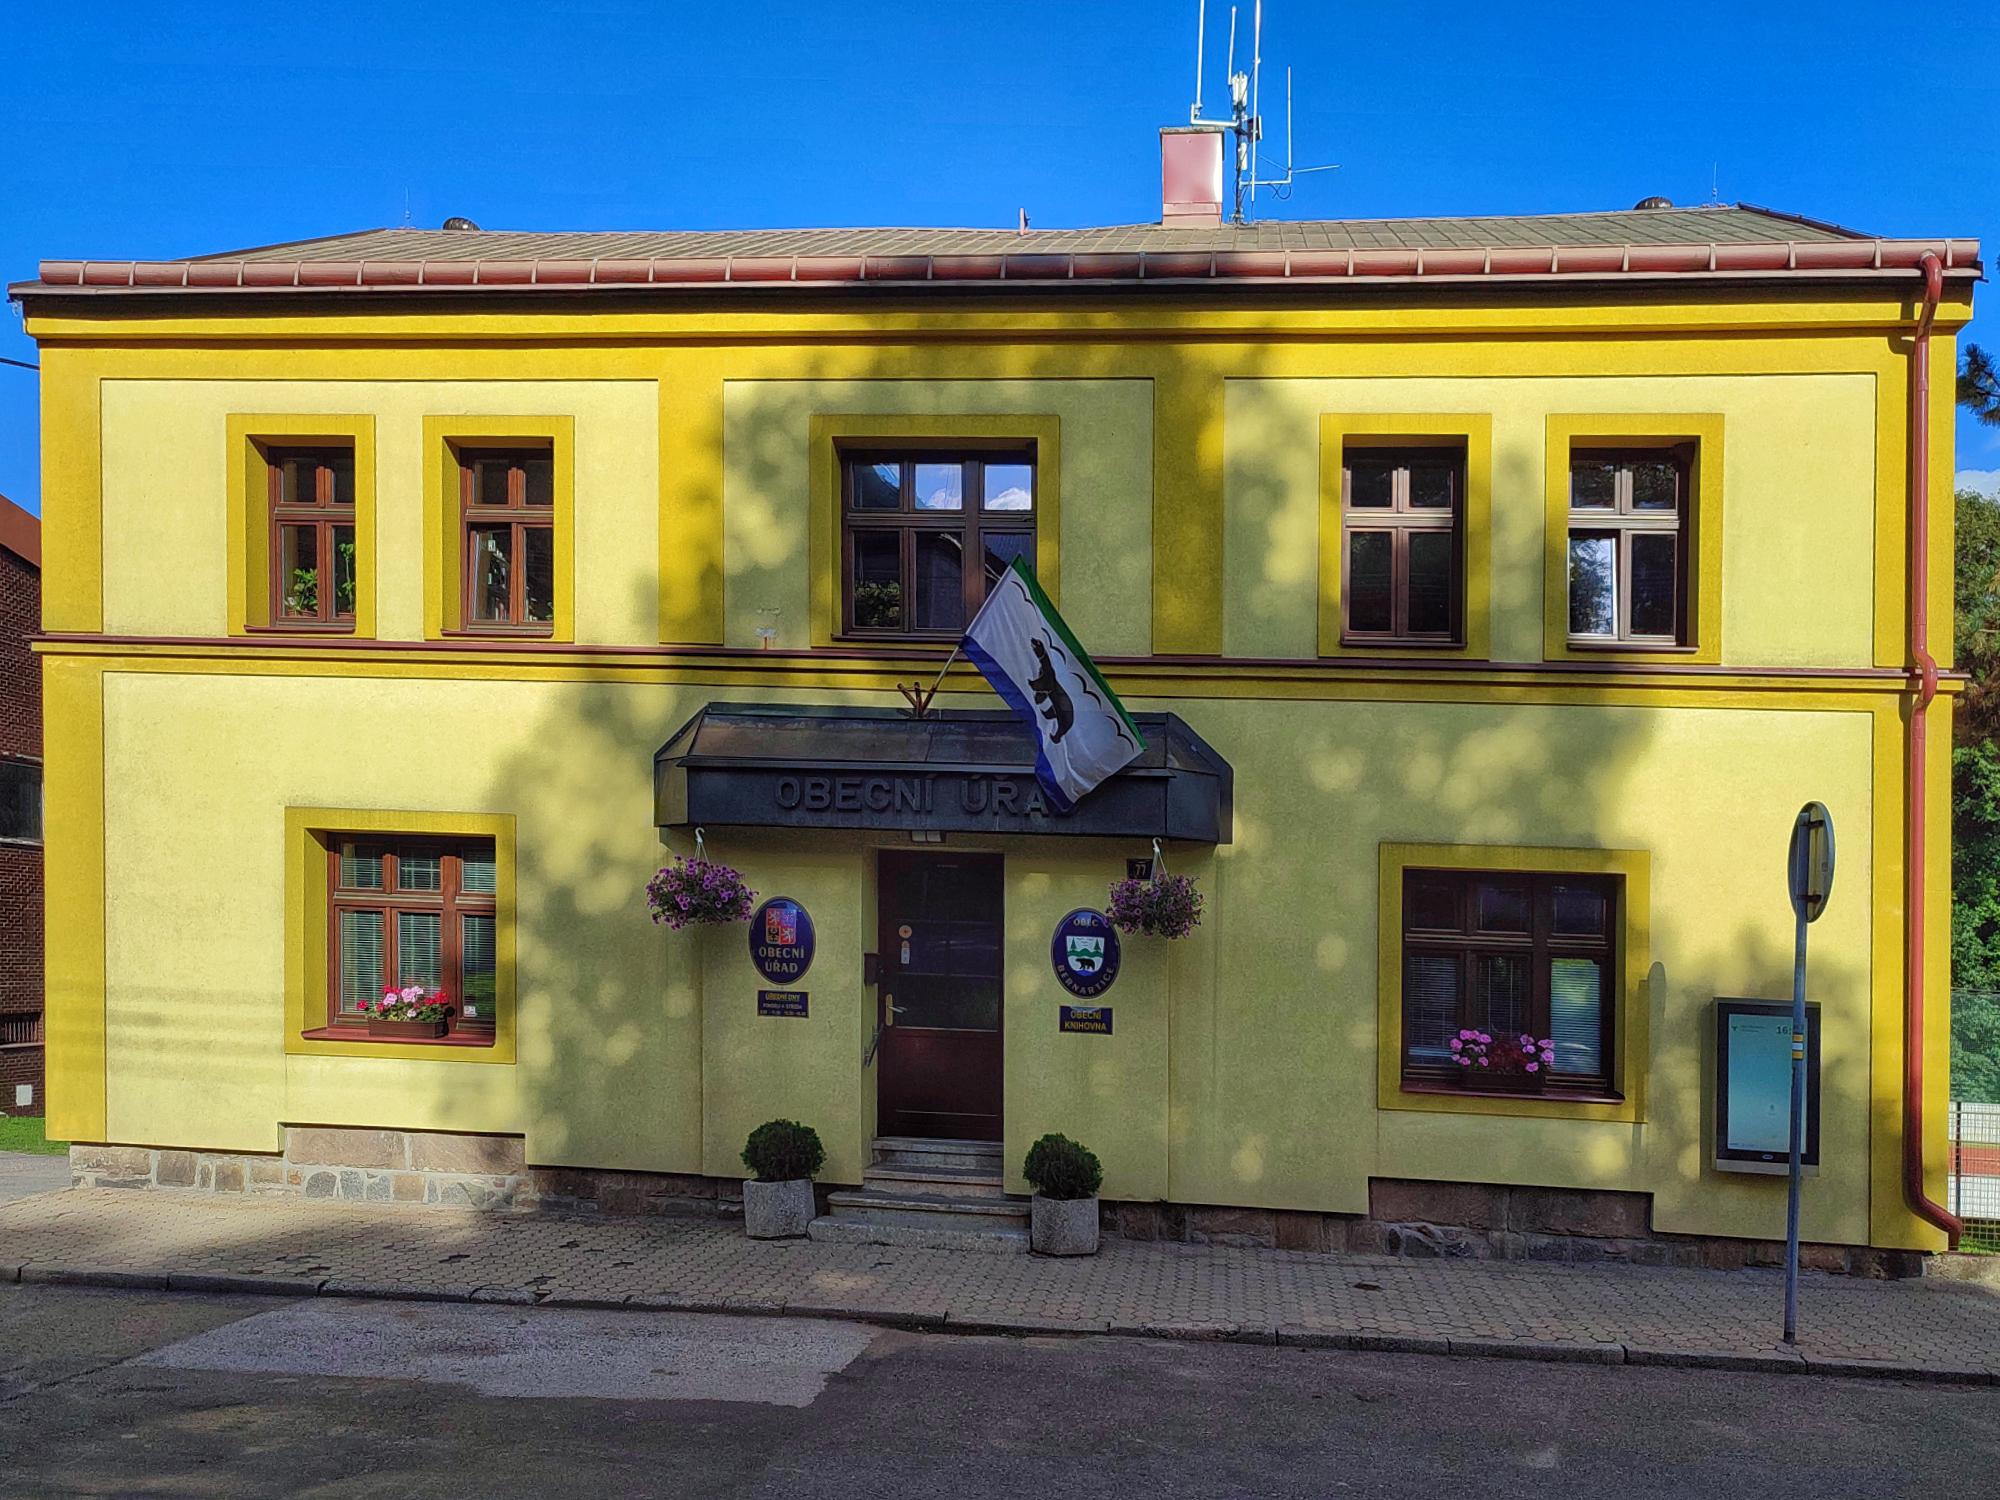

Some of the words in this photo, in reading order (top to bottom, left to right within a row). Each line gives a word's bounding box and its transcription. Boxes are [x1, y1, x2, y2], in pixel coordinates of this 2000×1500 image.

[775, 774, 934, 814] OBECNÍ
[959, 773, 1056, 816] ÚŘA
[1072, 918, 1099, 928] OBEC
[758, 945, 805, 959] OBECNÍ
[764, 959, 798, 973] ÚŘAD
[1056, 964, 1115, 995] BERNARTICE
[1070, 1010, 1102, 1020] OBECNÍ
[1064, 1021, 1107, 1031] KNIHOVNA
